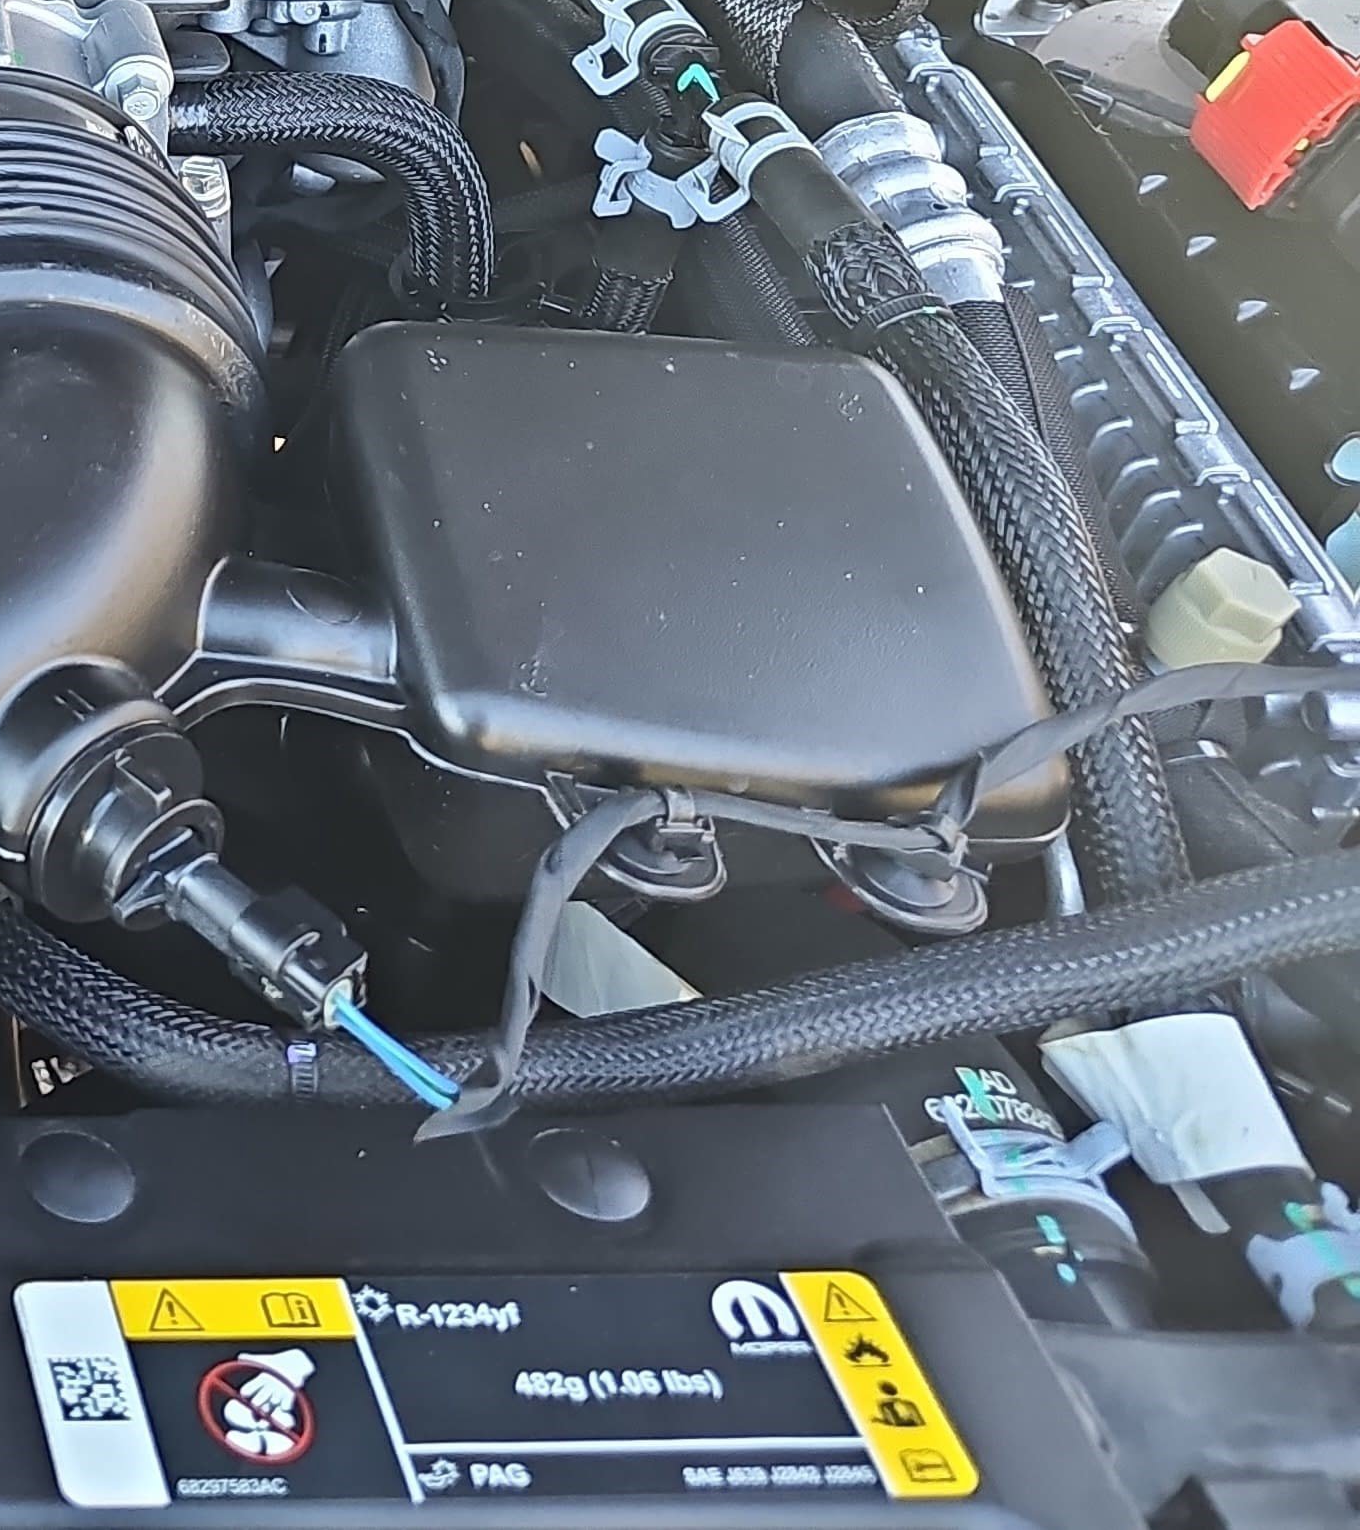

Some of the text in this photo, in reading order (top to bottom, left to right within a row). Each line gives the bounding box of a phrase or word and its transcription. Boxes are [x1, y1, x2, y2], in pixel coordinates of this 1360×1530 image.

[395, 1300, 521, 1332] R-1234yf
[514, 1370, 724, 1401] 482g (1.06 lbs)
[470, 1463, 532, 1488] PAG
[683, 1466, 724, 1487] SAE
